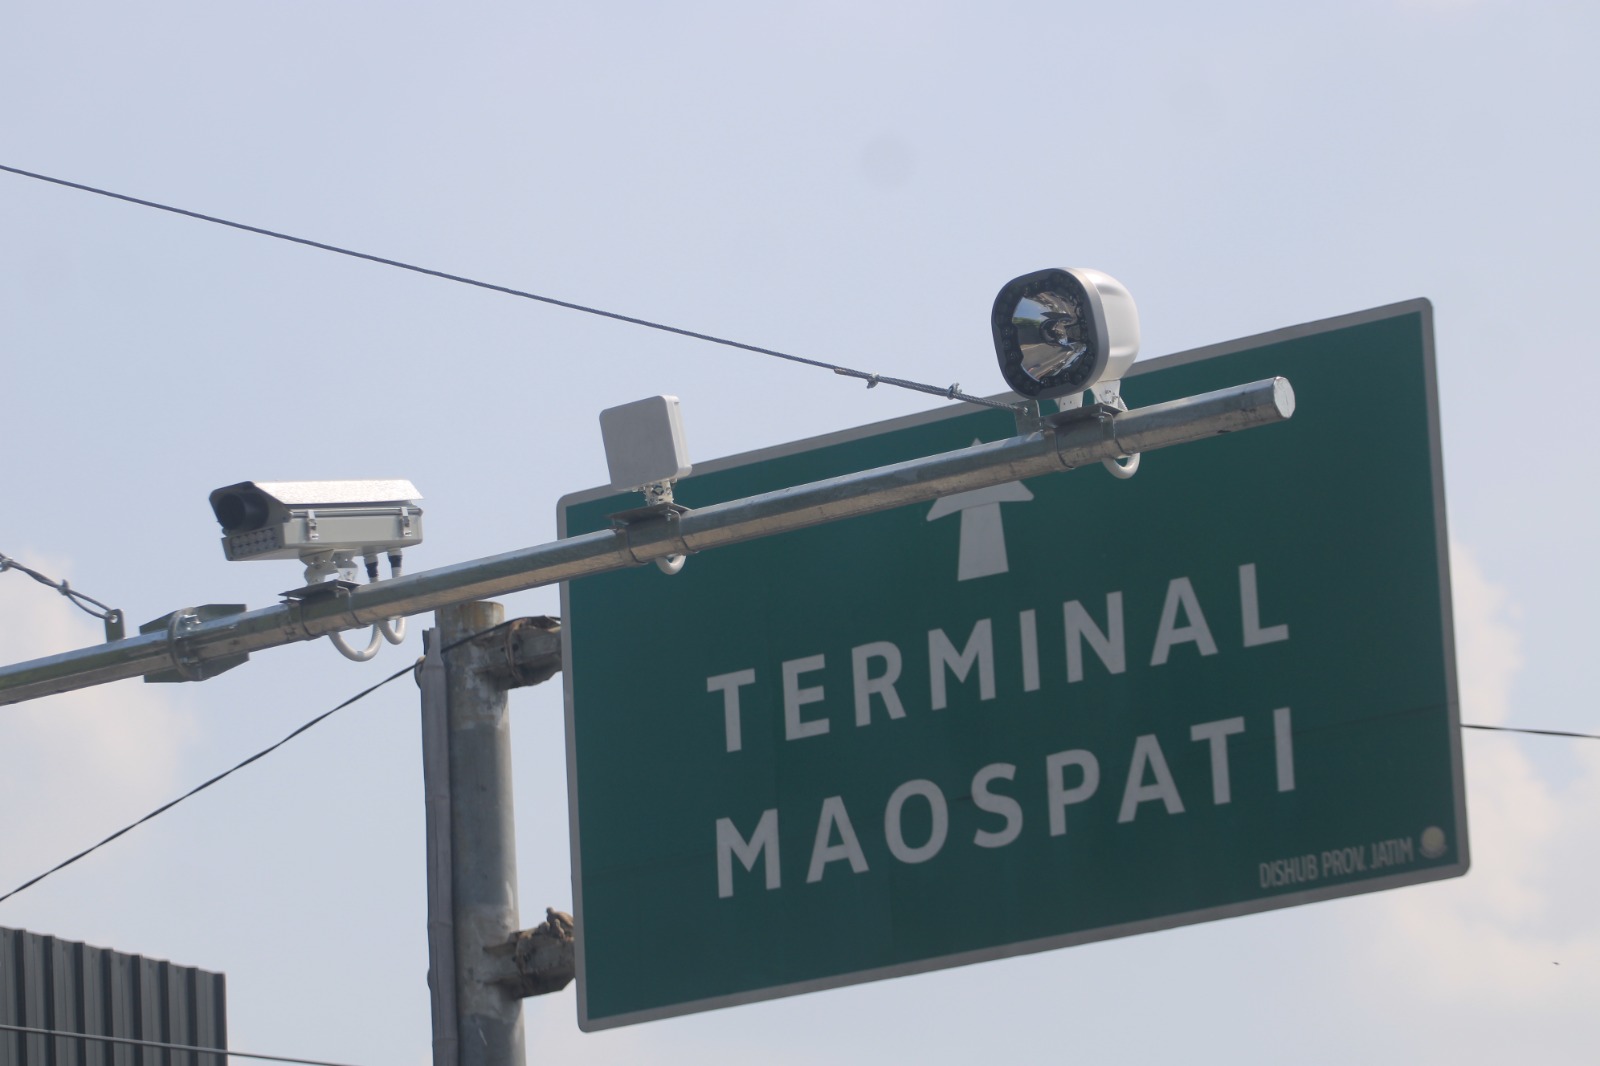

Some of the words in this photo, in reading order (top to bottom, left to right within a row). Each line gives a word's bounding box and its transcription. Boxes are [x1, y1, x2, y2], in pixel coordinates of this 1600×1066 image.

[706, 563, 1289, 753] TERMINAL
[715, 707, 1295, 899] MAOSPATI
[1259, 854, 1319, 889] DISHUB
[1322, 846, 1366, 878] PROV.
[1370, 837, 1414, 869] JATIM
